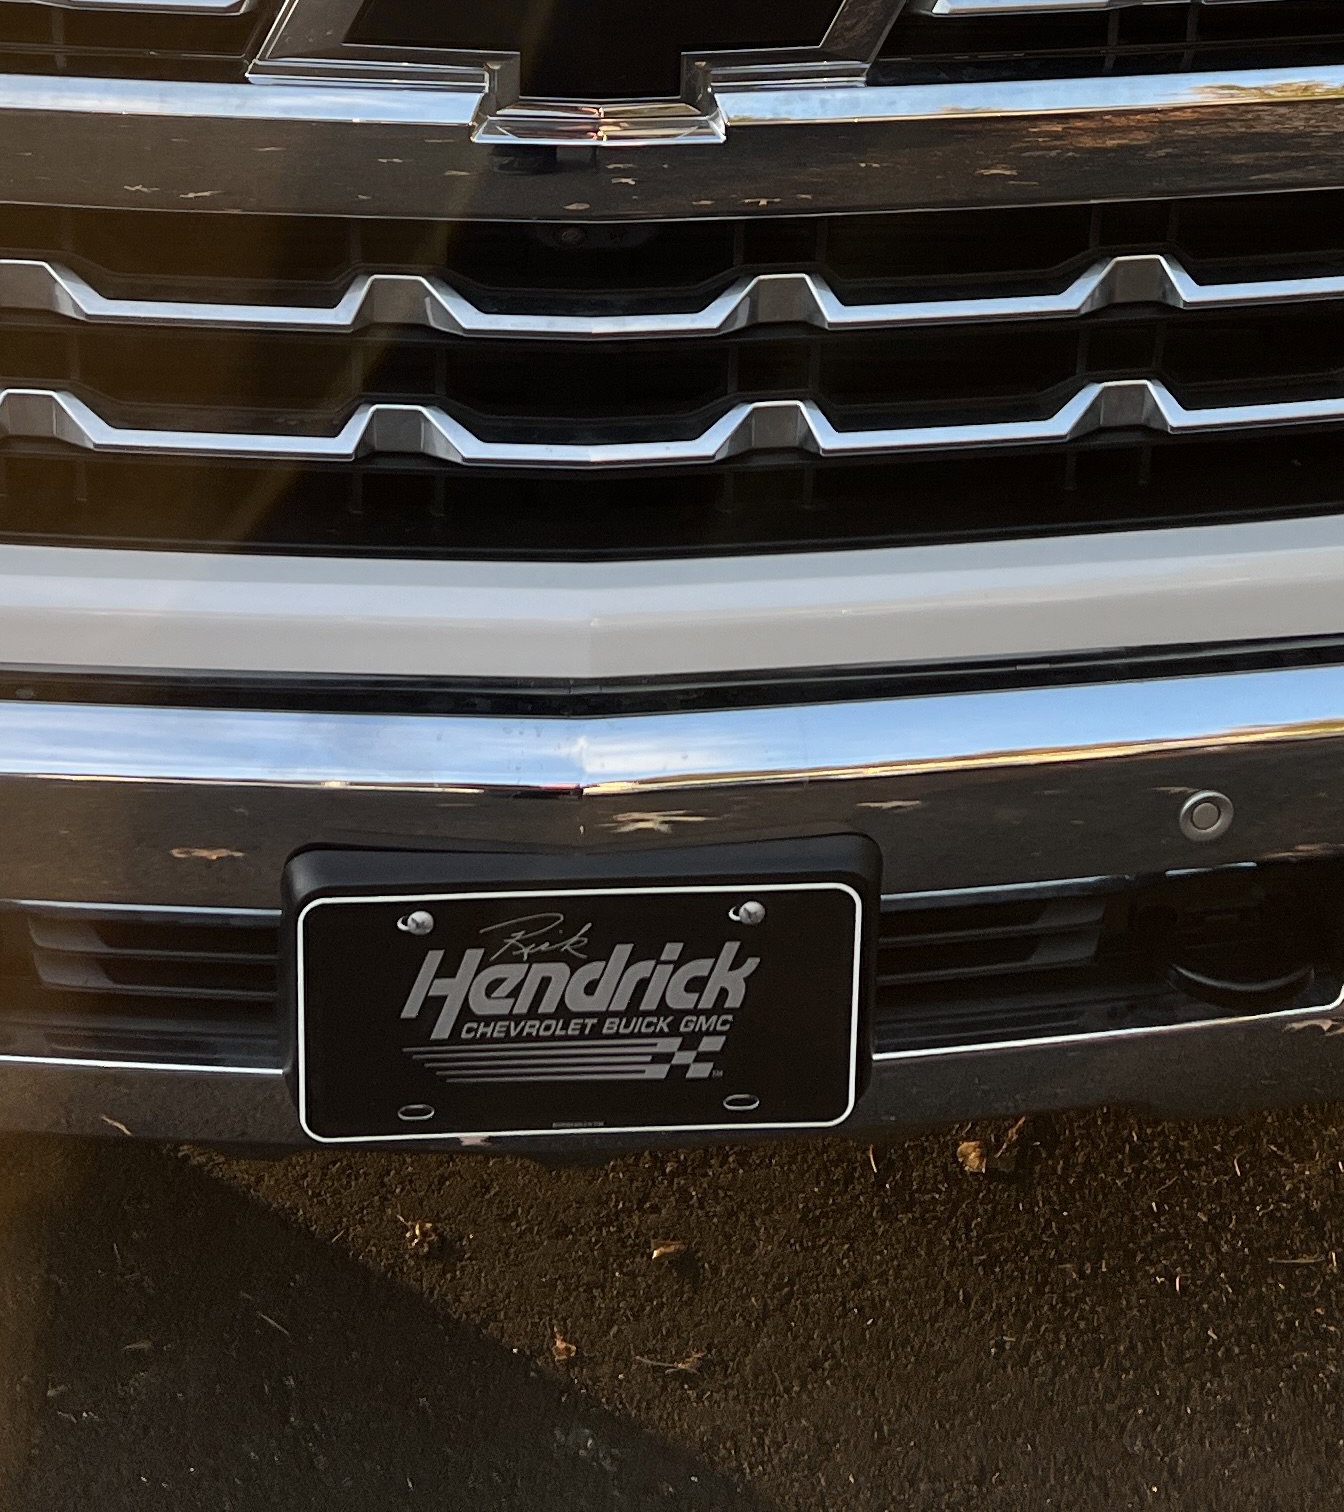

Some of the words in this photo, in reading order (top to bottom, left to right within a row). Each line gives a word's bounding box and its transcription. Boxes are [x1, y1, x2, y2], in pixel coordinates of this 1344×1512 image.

[400, 941, 761, 1040] Hendrick
[460, 1018, 598, 1039] CHEVROLET
[602, 1015, 673, 1036] BUICK
[679, 1014, 734, 1033] GMC
